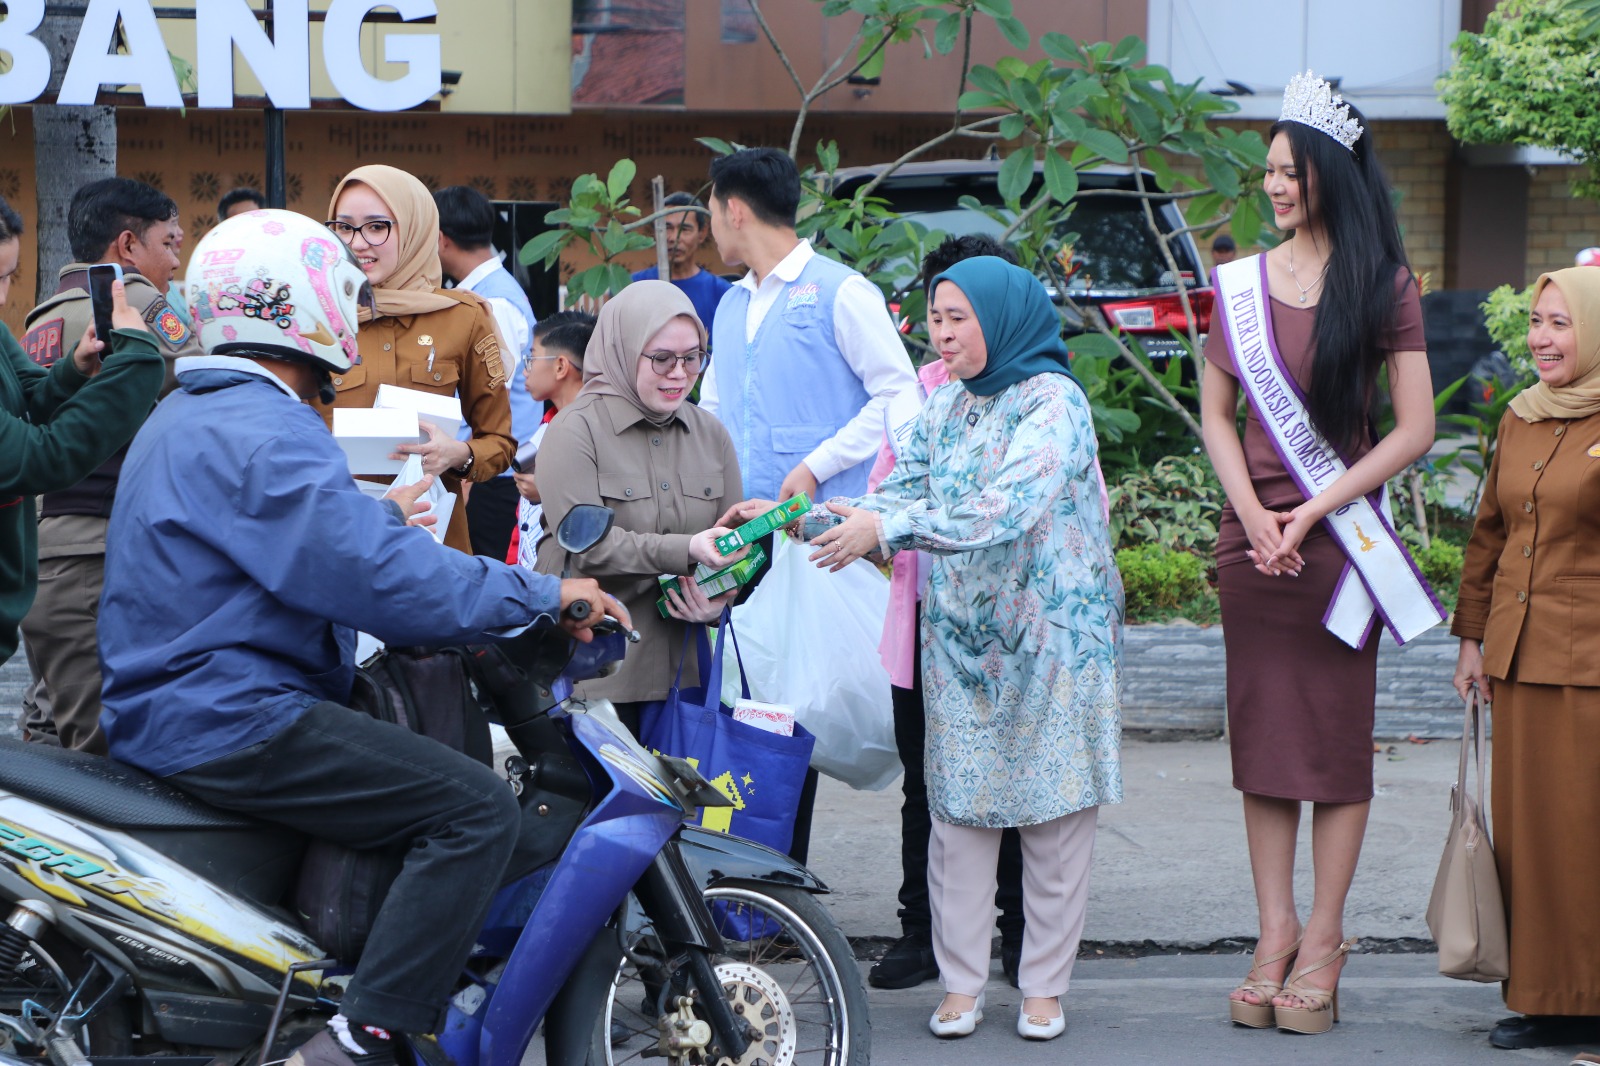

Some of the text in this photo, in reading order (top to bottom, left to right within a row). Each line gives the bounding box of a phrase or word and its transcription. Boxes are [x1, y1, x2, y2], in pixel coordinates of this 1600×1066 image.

[1231, 287, 1261, 346] PUTERI
[1242, 343, 1297, 429] INDONESIA
[1284, 421, 1336, 487] SUMSEL
[147, 947, 189, 966] BRAKE
